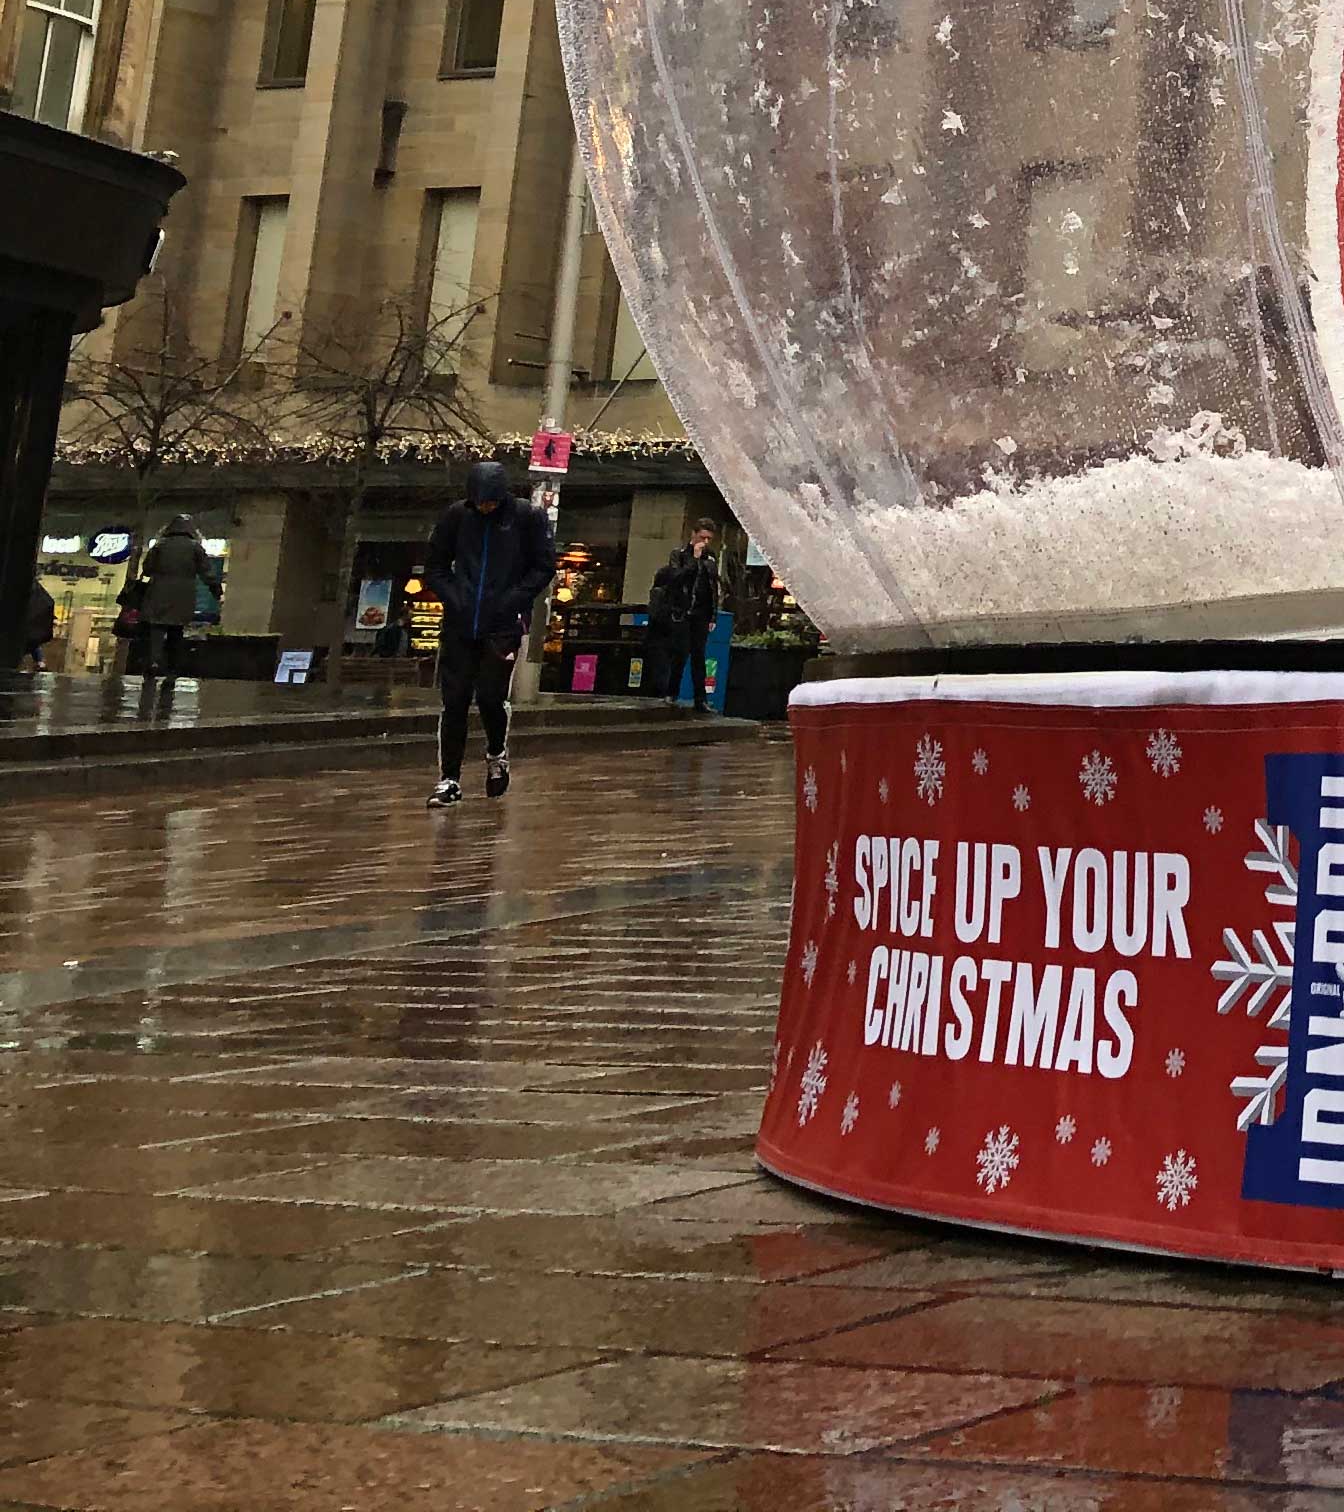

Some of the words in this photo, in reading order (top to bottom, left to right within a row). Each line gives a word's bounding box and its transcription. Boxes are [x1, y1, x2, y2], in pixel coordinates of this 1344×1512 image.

[855, 834, 937, 938] SPICE
[953, 841, 1022, 944] UP
[1037, 845, 1192, 959] YOUR
[864, 944, 1138, 1080] CHRISTMAS
